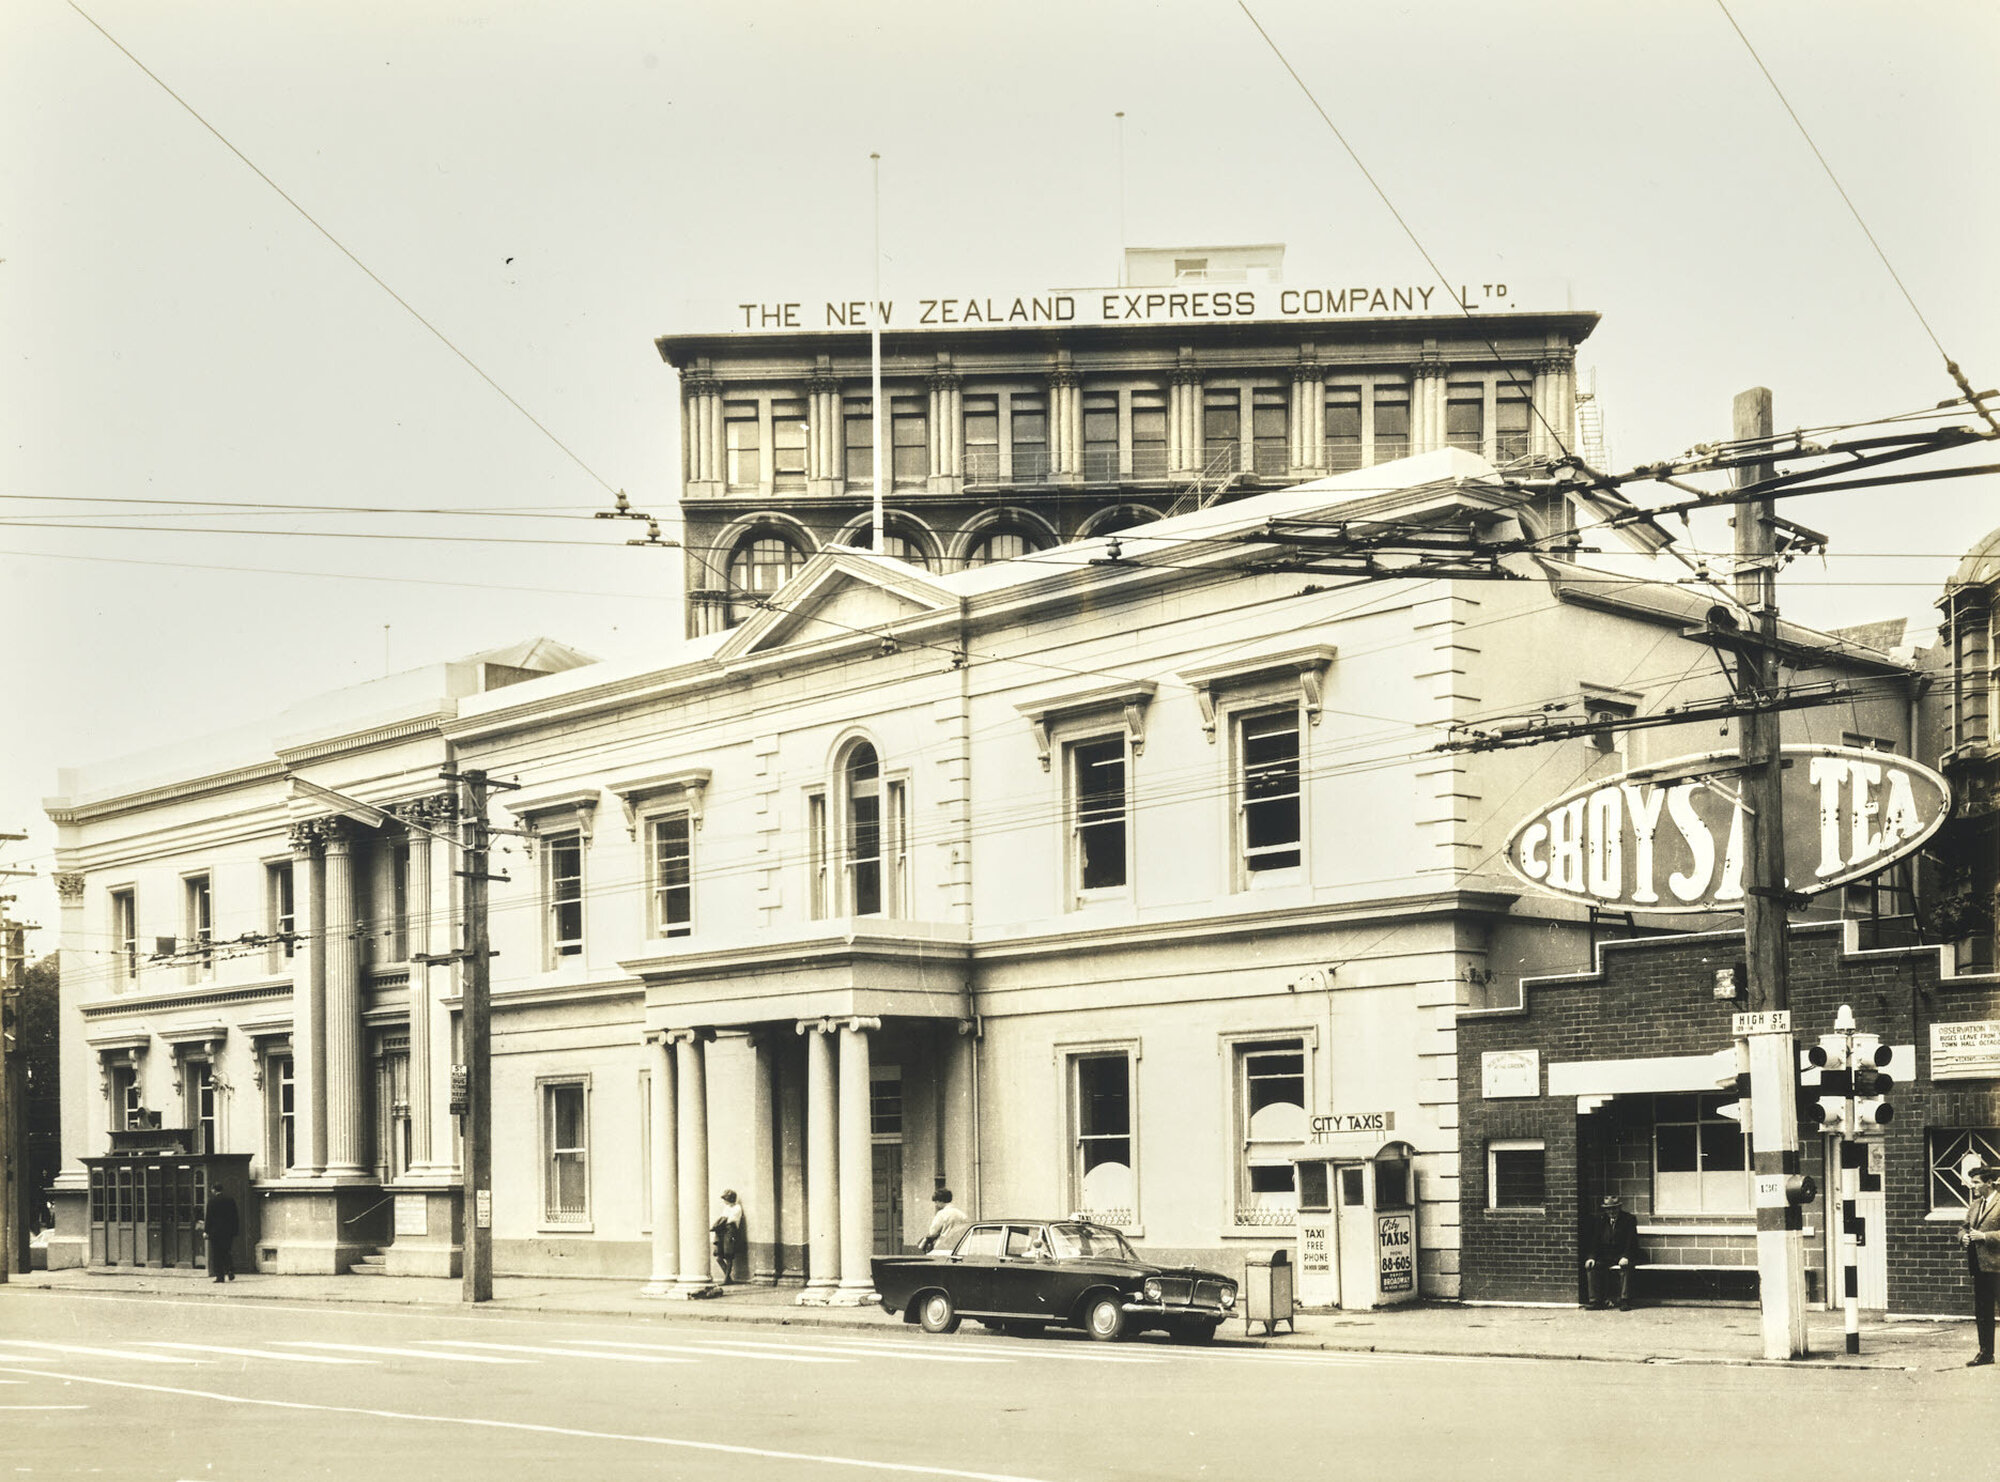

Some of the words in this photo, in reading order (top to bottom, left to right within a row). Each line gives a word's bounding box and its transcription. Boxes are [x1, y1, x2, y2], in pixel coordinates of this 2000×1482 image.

[738, 303, 801, 328] THE
[826, 301, 893, 326] NEW
[919, 297, 1075, 324] ZEALAND
[1102, 291, 1256, 320] EXPRESS
[1280, 286, 1435, 315] COMPANY
[1809, 756, 1925, 877] TEA
[1739, 1014, 1764, 1025] HIGH
[1312, 1115, 1343, 1131] CITY
[1347, 1114, 1383, 1130] TAXIS
[1382, 1218, 1400, 1233] City
[1304, 1228, 1325, 1239] TAXI
[1380, 1231, 1410, 1247] TAXIS
[1306, 1241, 1324, 1250] FREE
[1303, 1253, 1329, 1262] PHONE
[1382, 1256, 1412, 1271] 88-605
[1383, 1277, 1411, 1286] BROADWAY
